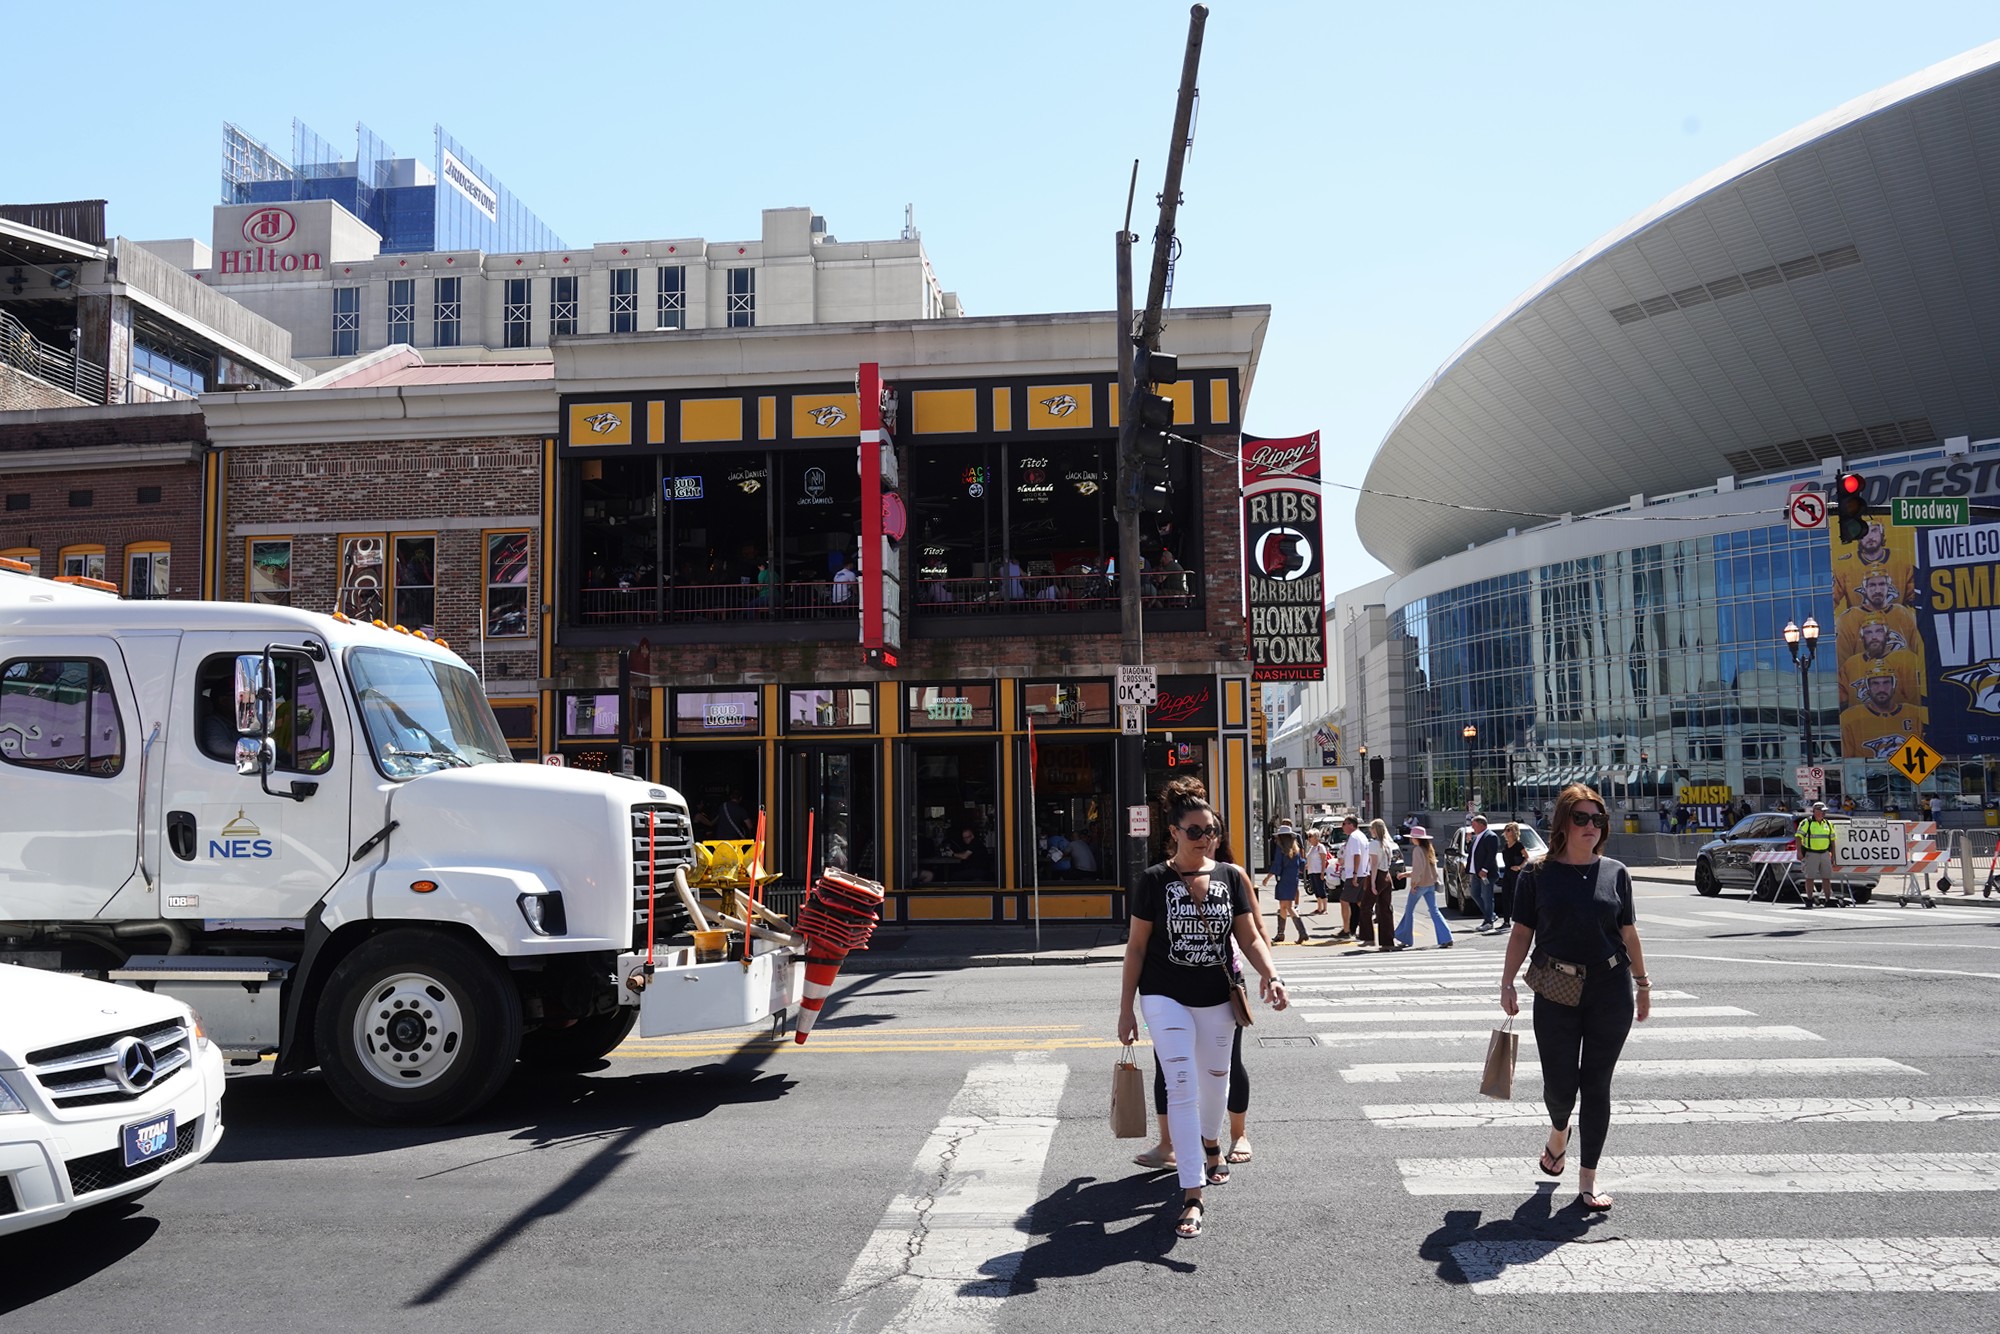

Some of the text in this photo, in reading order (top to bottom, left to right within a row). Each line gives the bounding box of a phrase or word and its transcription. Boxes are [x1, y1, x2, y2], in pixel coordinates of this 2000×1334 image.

[445, 158, 496, 214] BRIDGESTONE
[220, 248, 321, 275] Hilton
[1246, 434, 1318, 471] Rippy's
[1250, 491, 1317, 524] RIBS
[1901, 500, 1959, 524] Broadway
[1249, 572, 1322, 602] BARBEQUE
[1251, 605, 1320, 635] HONKY
[1253, 635, 1322, 664] TONK
[1122, 667, 1152, 675] DIAGONAL
[1122, 674, 1152, 682] CROSSING
[1255, 668, 1321, 681] NASHVILLE
[1119, 685, 1134, 700] OK
[710, 705, 737, 716] BUD
[927, 703, 973, 720] SELTZER
[705, 714, 744, 726] LIGHT
[1167, 748, 1176, 767] 6
[1680, 786, 1728, 804] SMASH
[1848, 829, 1890, 842] ROAD
[209, 839, 273, 858] NES
[1841, 847, 1900, 860] CLOSED
[168, 896, 187, 907] 108
[1171, 920, 1229, 934] WHISKEY
[1185, 951, 1216, 963] Wine
[137, 1120, 168, 1141] TITAN
[151, 1133, 167, 1151] UP
